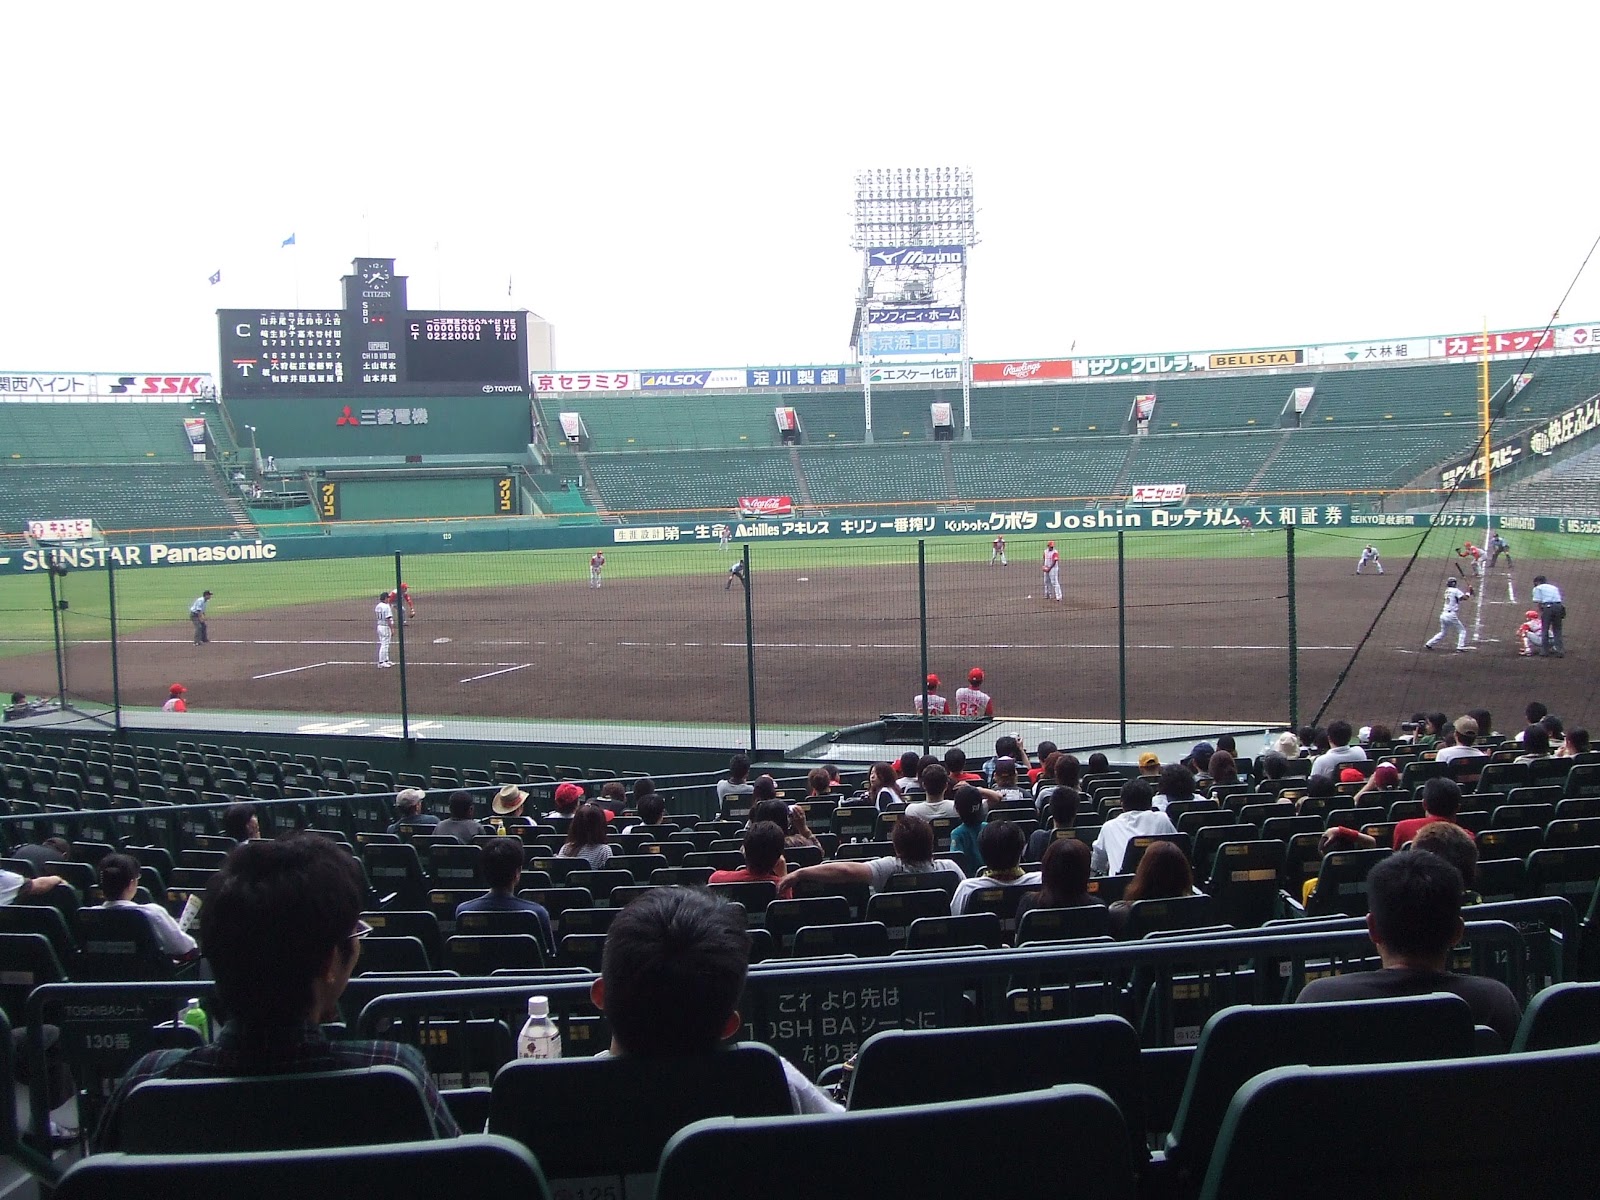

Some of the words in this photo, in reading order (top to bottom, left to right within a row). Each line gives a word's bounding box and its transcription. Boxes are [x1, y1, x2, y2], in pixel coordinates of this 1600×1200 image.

[236, 324, 250, 336] C
[1365, 344, 1408, 358] 大林組
[1089, 358, 1188, 376] サン・クロレラ
[1216, 353, 1289, 366] BELISTA
[237, 364, 253, 376] T
[883, 368, 958, 380] エスケー化研
[1003, 362, 1041, 376] Rawlings
[0, 376, 84, 392] 関西ペイント
[141, 377, 201, 394] SSK
[538, 374, 630, 391] 京セラミタ
[655, 374, 705, 386] ALSOK
[753, 370, 839, 386] 淀川製鋼
[361, 408, 428, 425] 三菱電機
[322, 484, 336, 516] グリコ
[499, 479, 512, 510] グリコ
[944, 520, 989, 532] Kubota
[989, 512, 1038, 531] クボタ
[1046, 510, 1141, 528] Joshin
[1152, 508, 1242, 526] ロッテガム
[1256, 506, 1342, 525] 大和証券
[1350, 516, 1378, 524] SEIKYO
[1500, 516, 1535, 530] SHIMANO
[736, 525, 780, 538] Achilles
[782, 522, 830, 535] アキレス
[22, 547, 142, 571] SUNSTAR
[150, 540, 276, 564] Panasonic
[86, 1033, 130, 1049] 130番
